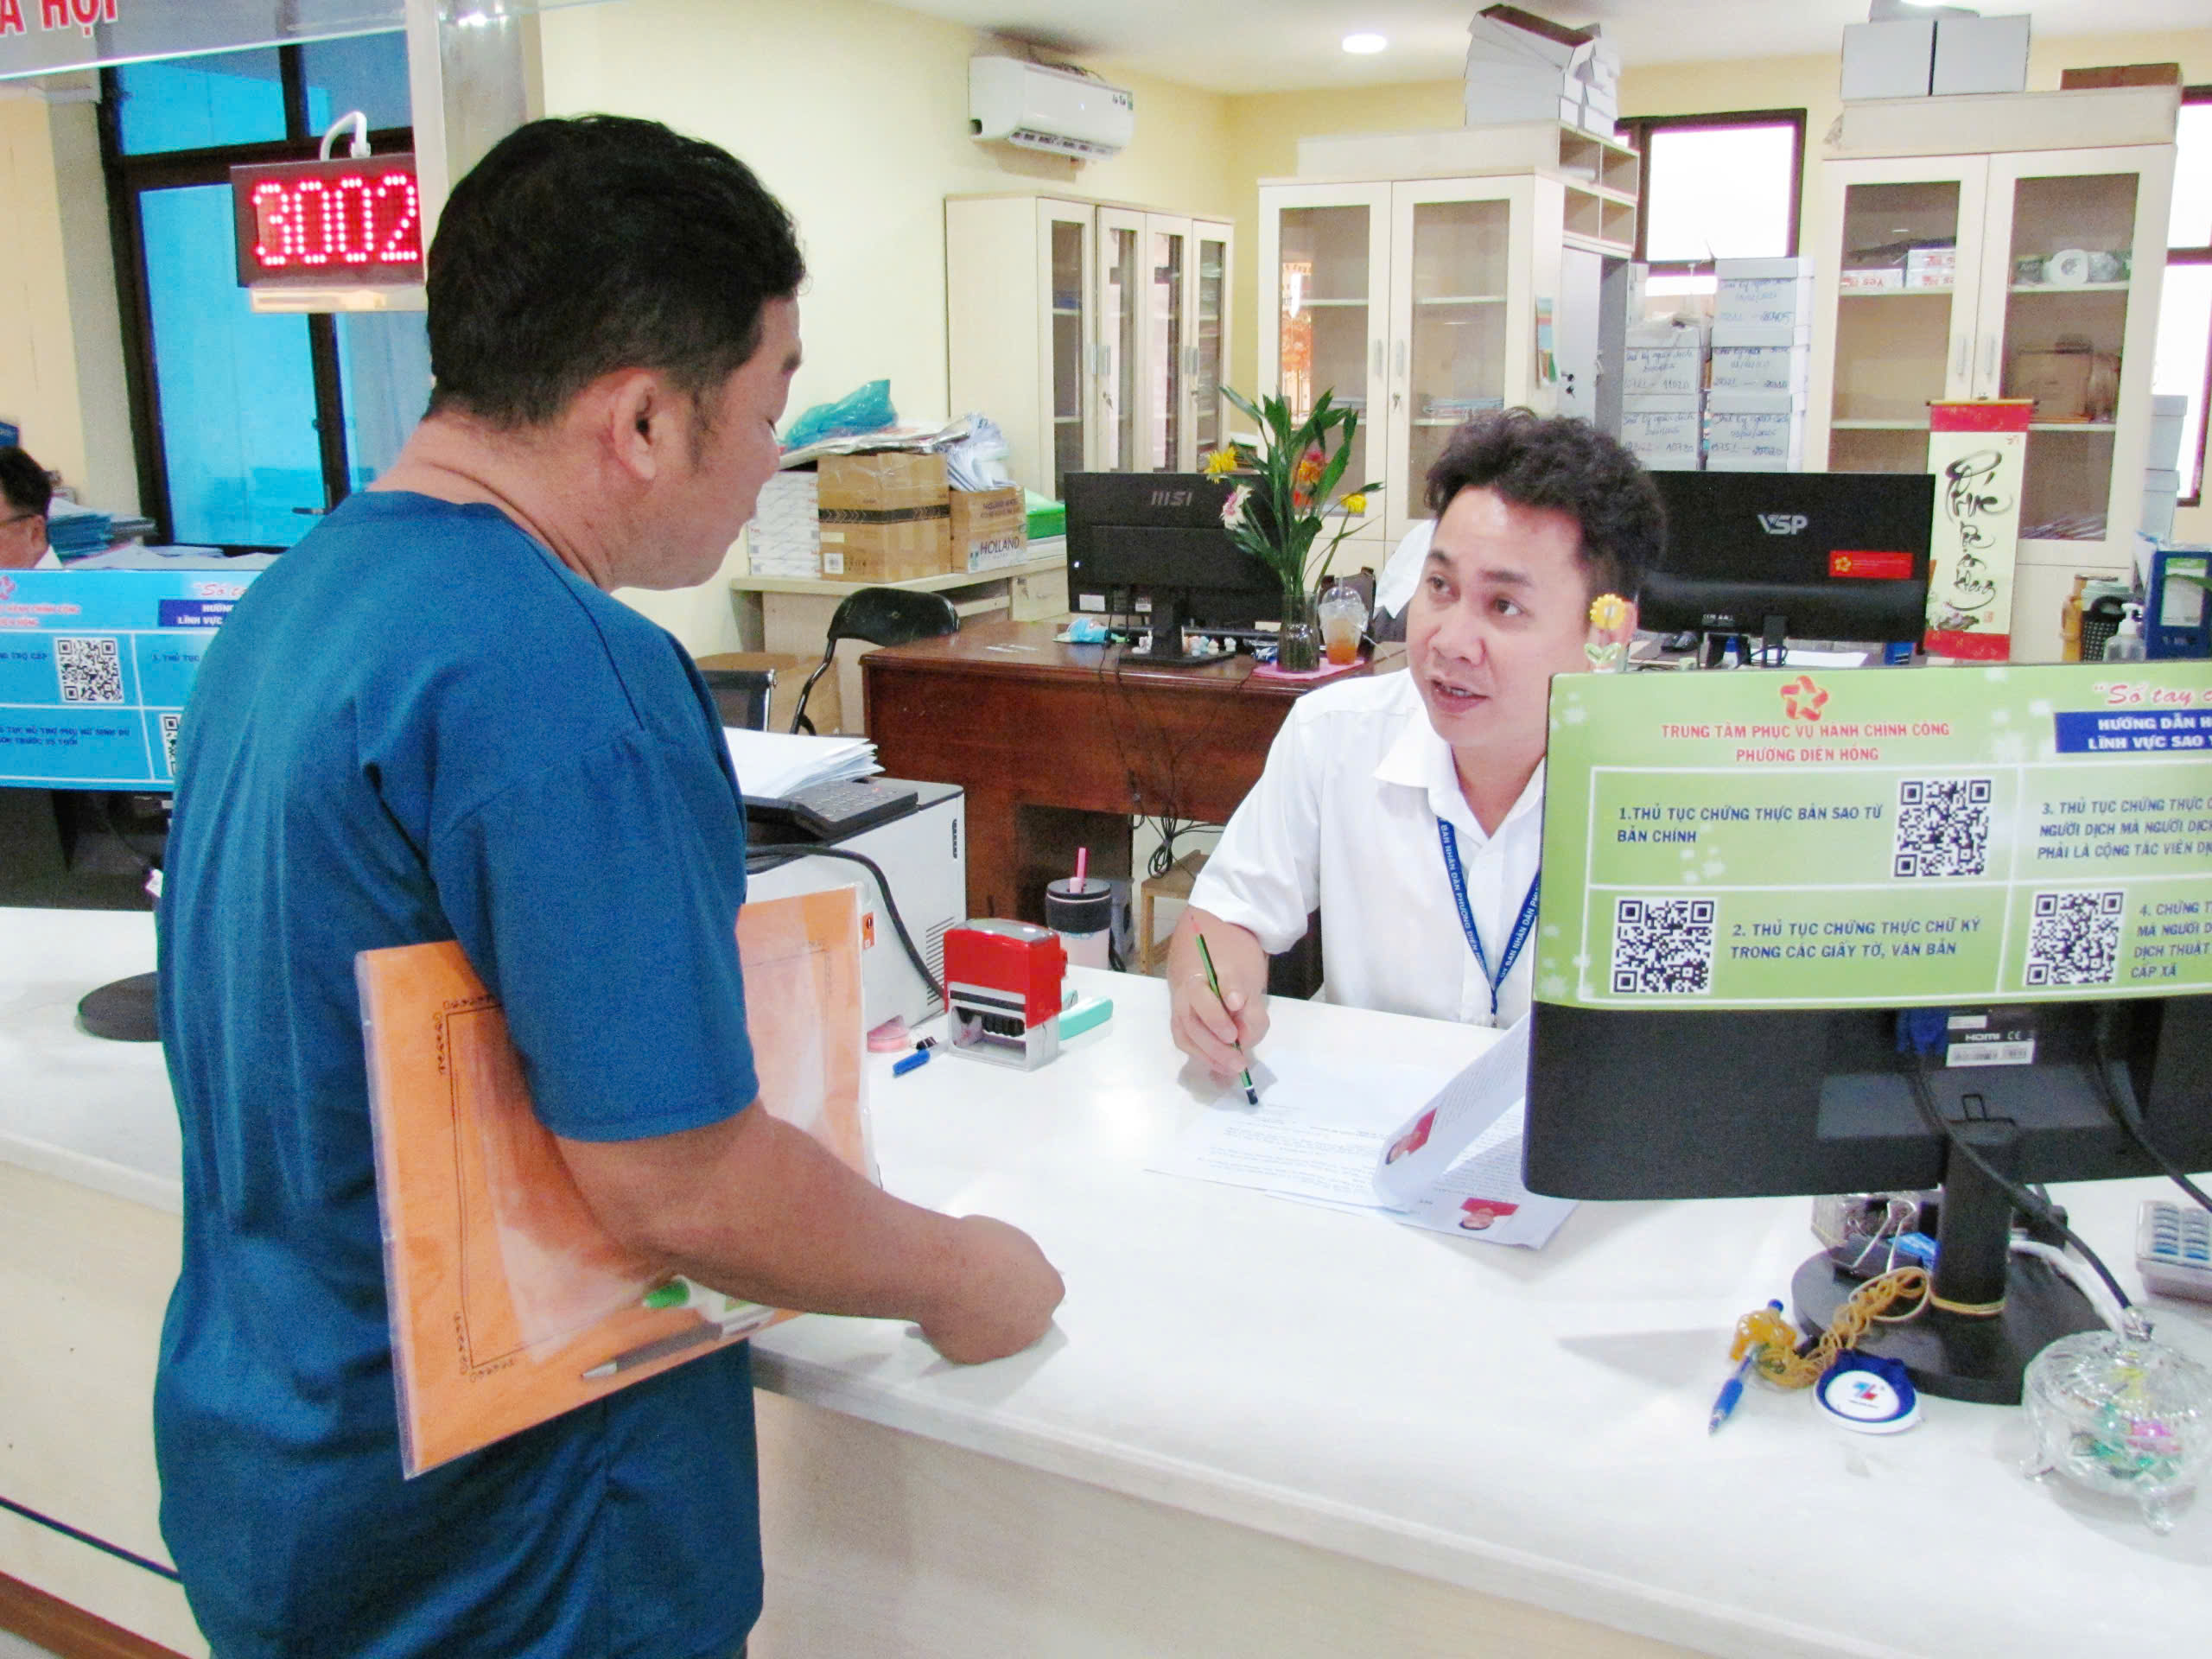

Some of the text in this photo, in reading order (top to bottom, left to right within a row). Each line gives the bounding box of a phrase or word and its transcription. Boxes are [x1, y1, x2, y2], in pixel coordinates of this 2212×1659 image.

[252, 174, 418, 265] 3002
[1151, 490, 1193, 507] MSI
[1757, 513, 1808, 535] VSP
[980, 536, 1020, 556] HOLLAND
[2152, 689, 2193, 707] tay
[1661, 724, 1711, 739] TRUNG
[1751, 724, 1791, 741] PHỤC
[2097, 715, 2158, 731] HƯỚNG
[2087, 734, 2128, 750] LĨNH
[2132, 734, 2167, 751] VỰC
[2171, 734, 2204, 748] SAO
[1668, 807, 1696, 823] TỤC
[1700, 804, 1750, 821] CHỨNG
[1754, 804, 1794, 823] THỰC
[1797, 802, 1828, 821] BẢN
[1831, 806, 1859, 820] SAO
[2041, 802, 2055, 815] 3.
[2059, 796, 2087, 815] THỦ
[1617, 824, 1697, 843] BẢN CHÍNH
[2084, 822, 2116, 838] DỊCH
[1732, 923, 1747, 937] 2.
[1751, 918, 1783, 937] THỦ
[1789, 922, 1819, 938] TỤC
[1822, 918, 1876, 936] CHỨNG
[1880, 918, 1921, 937] THỰC
[1925, 916, 1957, 933] CHỮ
[1730, 945, 1782, 959] TRONG
[1785, 943, 1817, 958] CÁC
[1926, 938, 1958, 957] BẢN
